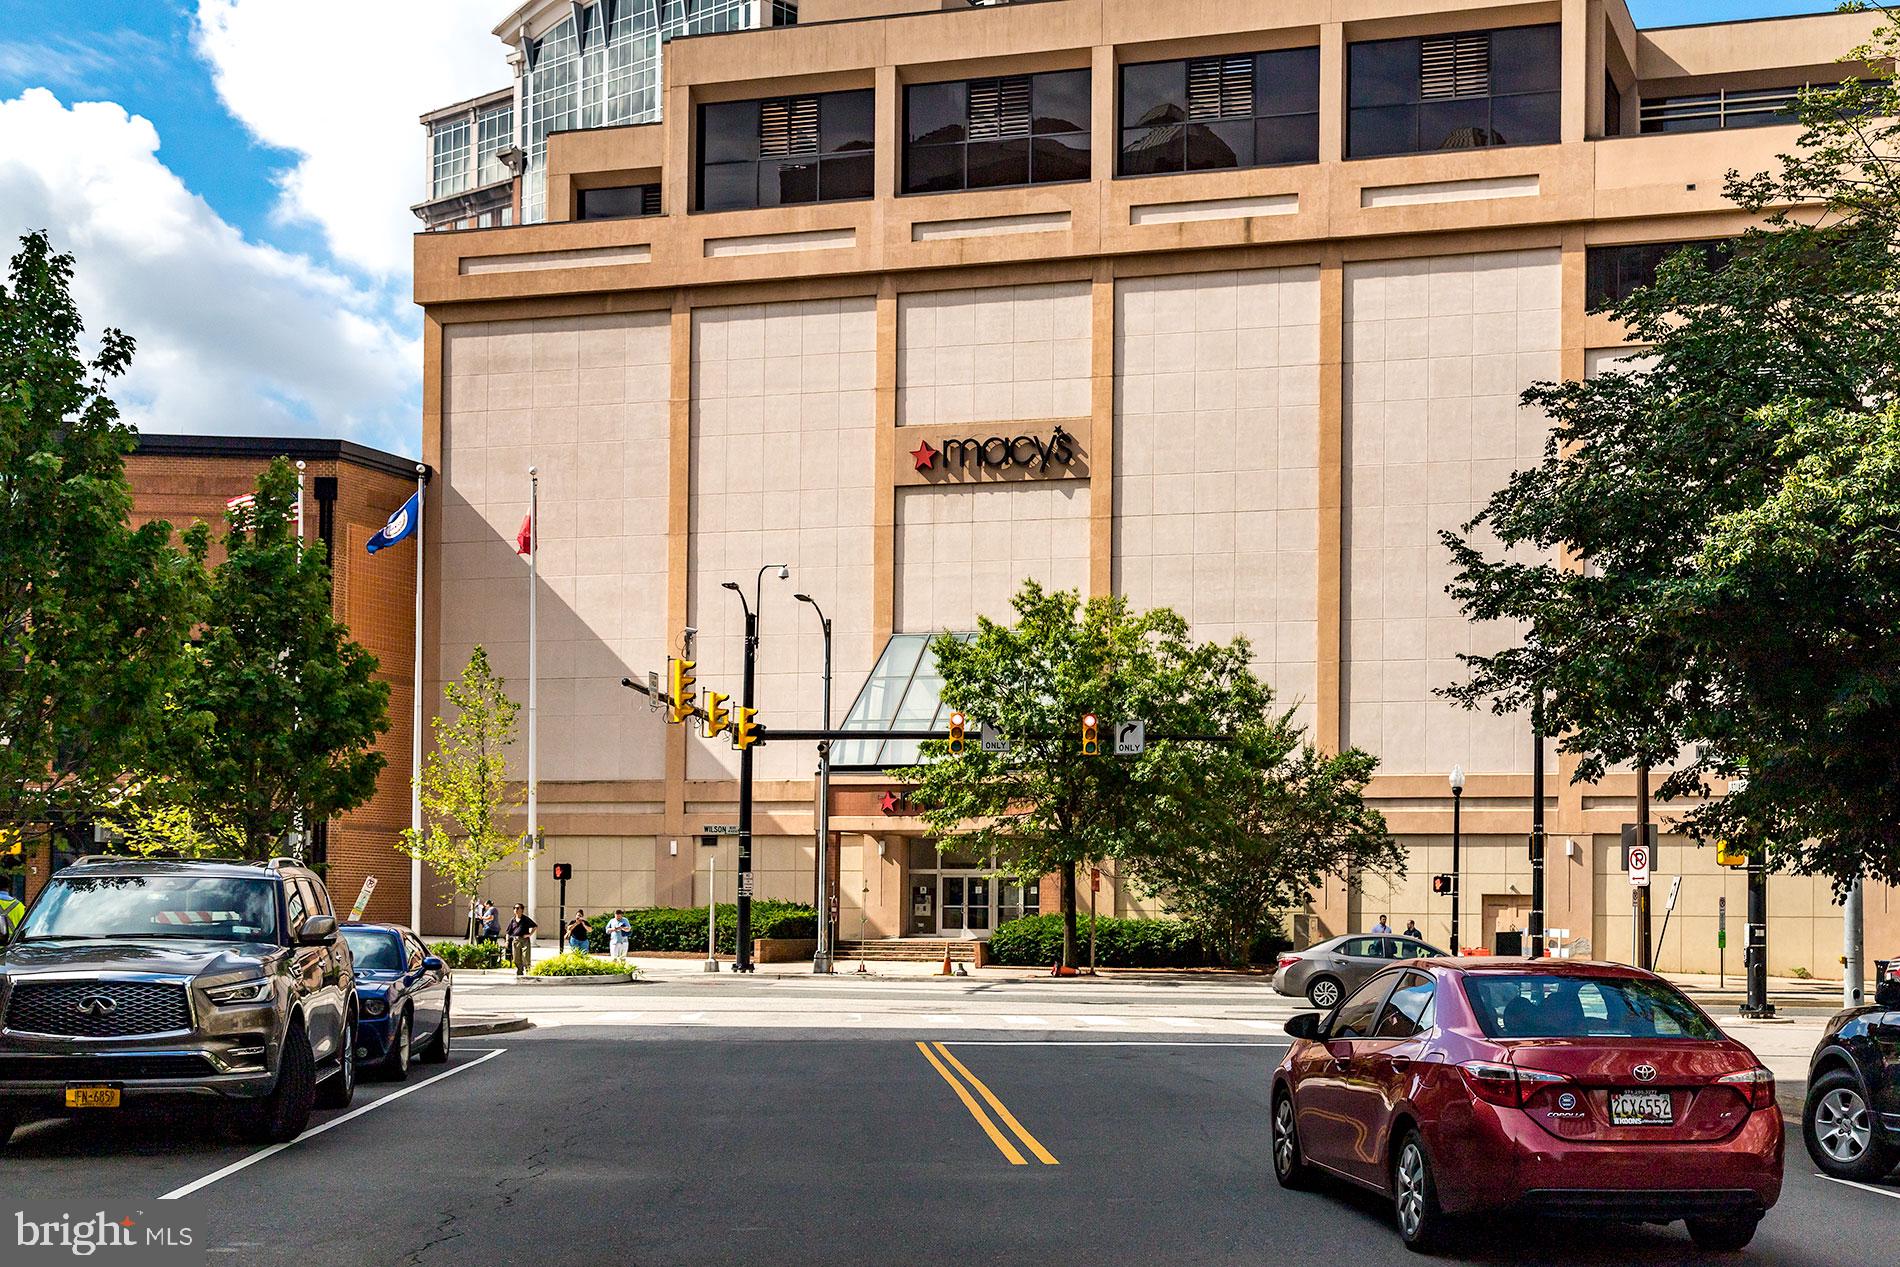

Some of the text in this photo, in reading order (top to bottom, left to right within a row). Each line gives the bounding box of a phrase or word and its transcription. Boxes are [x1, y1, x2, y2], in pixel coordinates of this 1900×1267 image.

[942, 425, 1073, 473] macy's
[985, 741, 1007, 749] ONLY
[1118, 744, 1141, 752] ONLY
[704, 825, 727, 833] WILSON
[1613, 1099, 1671, 1117] 2CX6552
